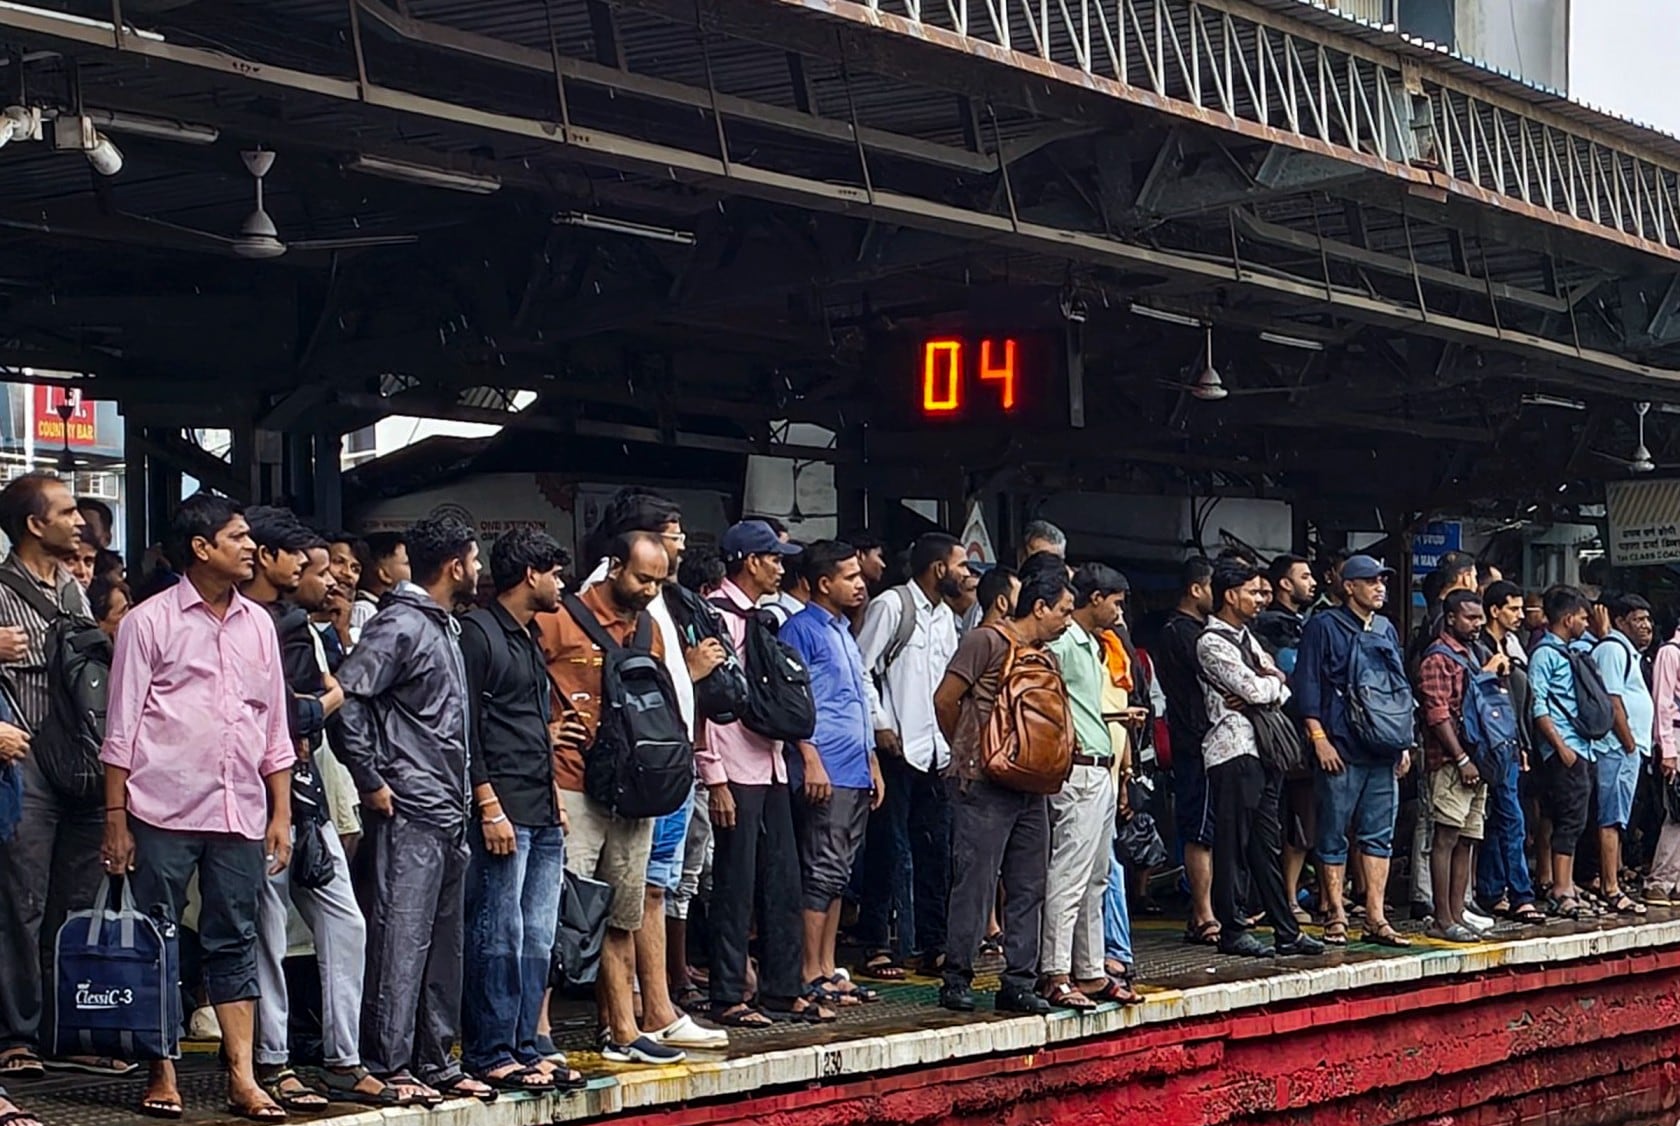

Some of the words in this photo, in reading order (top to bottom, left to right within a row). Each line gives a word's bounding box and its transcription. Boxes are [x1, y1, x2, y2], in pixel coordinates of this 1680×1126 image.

[923, 339, 1015, 411] 04
[76, 421, 94, 441] BAR
[1629, 551, 1656, 561] CLASS
